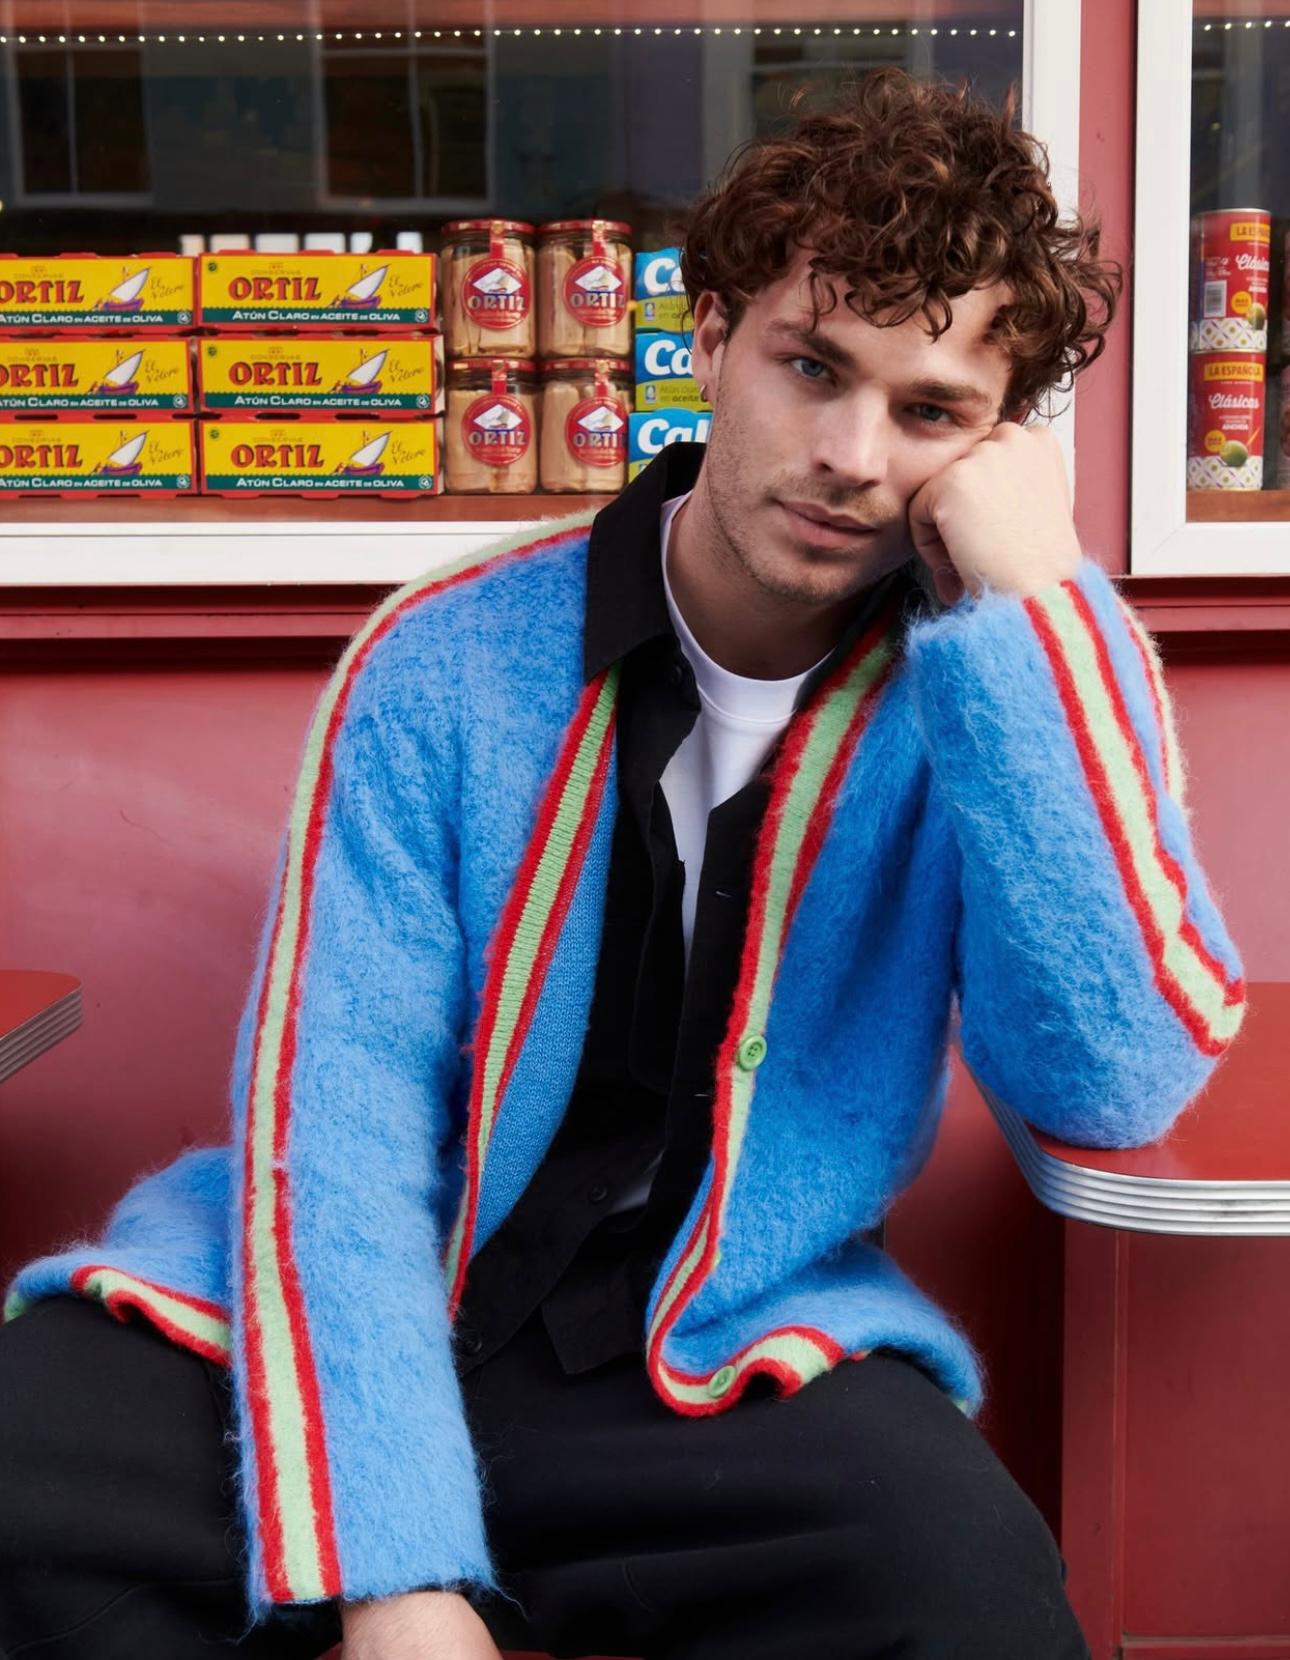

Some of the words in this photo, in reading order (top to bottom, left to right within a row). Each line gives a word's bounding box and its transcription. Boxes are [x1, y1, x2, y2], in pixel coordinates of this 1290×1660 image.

[228, 276, 321, 301] ORTIZ
[467, 295, 525, 311] ORTIZ
[31, 313, 73, 323] CLARO
[84, 315, 122, 323] ACEITE
[132, 315, 164, 323] OLIVA
[268, 310, 310, 321] CLARO
[320, 313, 359, 321] ACEITE
[369, 313, 401, 321] OLIVA
[228, 361, 322, 386] ORTIZ
[27, 397, 69, 407] CLARO
[79, 399, 118, 407] ACEITE
[128, 399, 160, 407] OLIVA
[270, 395, 312, 406] CLARO
[322, 398, 360, 406] ACEITE
[370, 398, 402, 406] OLIVA
[468, 431, 526, 446] ORTIZ
[230, 444, 324, 468] ORTIZ
[31, 478, 73, 488] CLARO
[83, 480, 121, 488] ACEITE
[131, 479, 162, 488] OLIVA
[272, 477, 314, 488] CLARO
[325, 480, 362, 488] ACEITE
[373, 480, 404, 488] OLIVA
